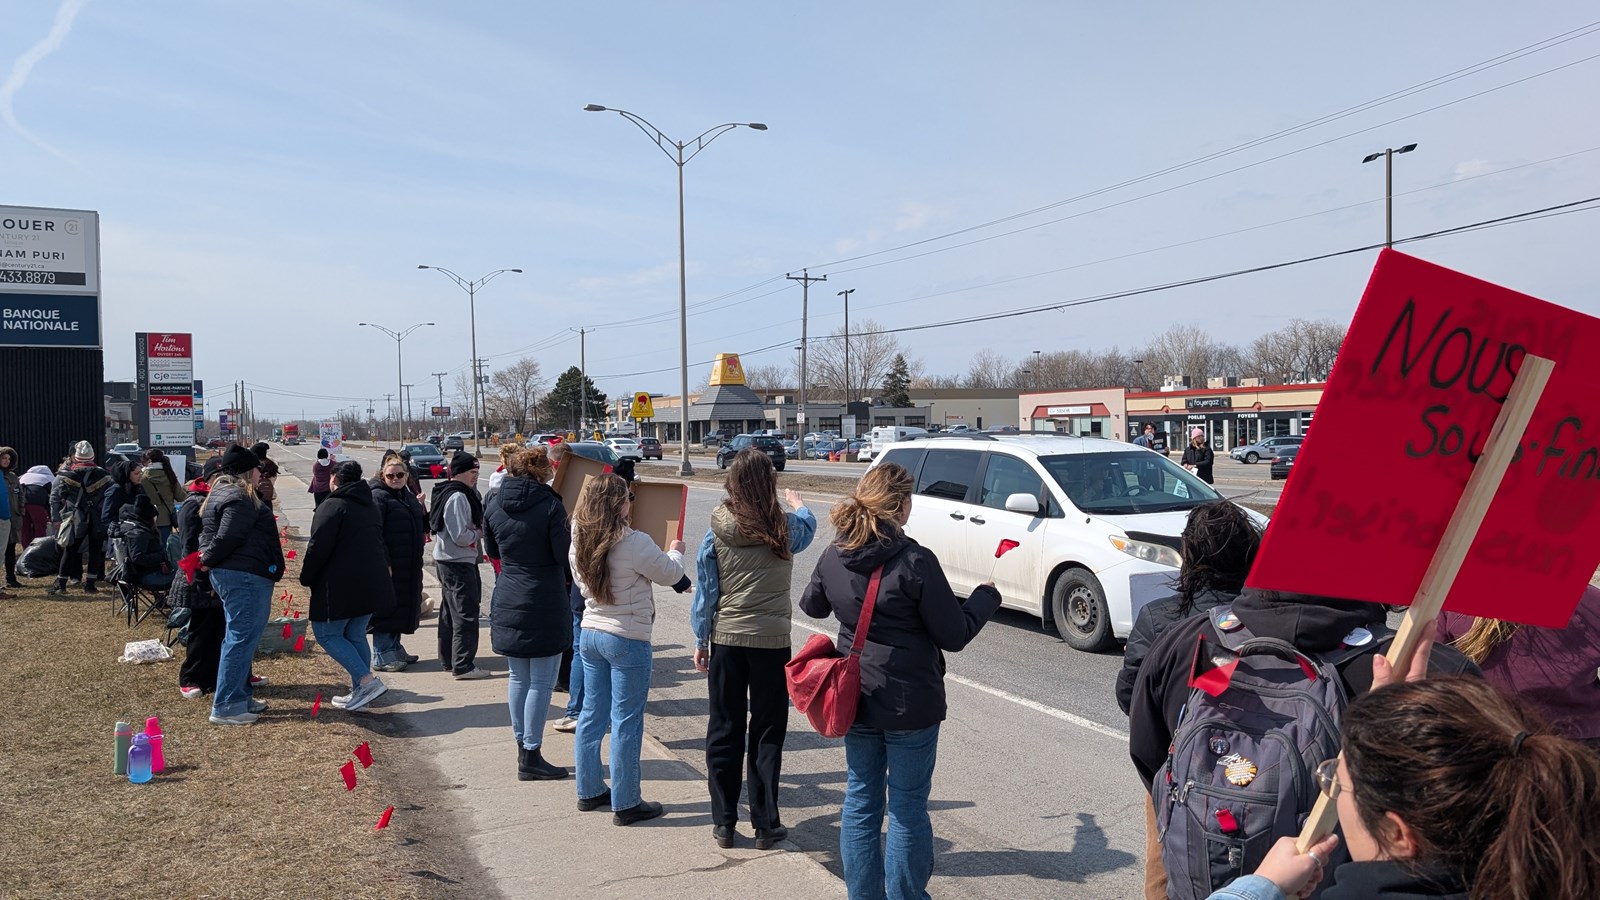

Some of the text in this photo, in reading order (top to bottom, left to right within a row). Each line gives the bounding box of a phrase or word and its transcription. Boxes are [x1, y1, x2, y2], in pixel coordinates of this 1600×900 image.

[32, 250, 65, 261] PURI
[0, 270, 56, 284] 433.8879
[2, 308, 61, 320] BANQUE
[2, 320, 80, 331] NATIONALE
[161, 334, 176, 344] Tim
[154, 342, 185, 352] Hortons
[153, 372, 170, 381] cje
[158, 398, 183, 407] Happy
[1193, 399, 1220, 408] foyergaz
